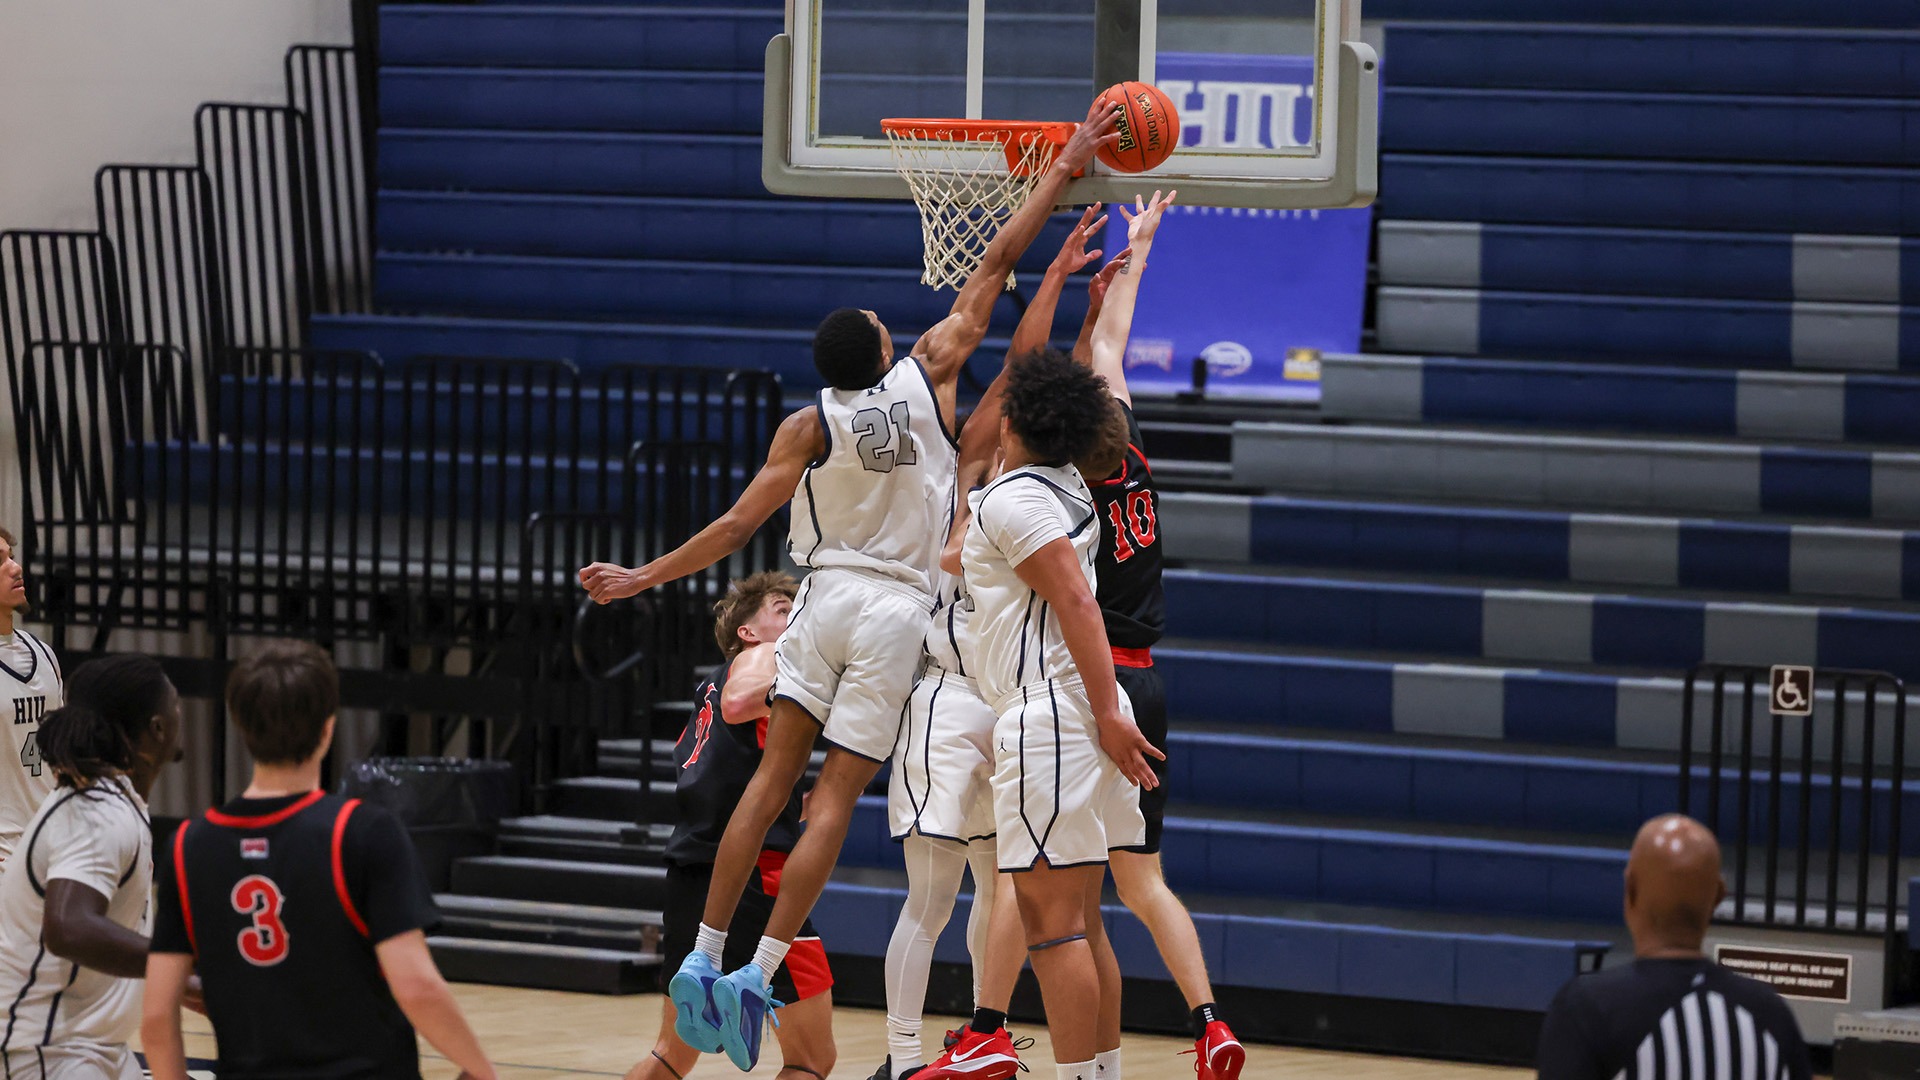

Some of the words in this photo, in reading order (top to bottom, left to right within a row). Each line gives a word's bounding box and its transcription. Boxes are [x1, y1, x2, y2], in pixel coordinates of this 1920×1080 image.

[1133, 92, 1160, 152] SPALDING
[851, 400, 917, 473] 21
[1108, 489, 1156, 563] 10
[12, 695, 46, 725] HIU
[20, 731, 42, 777] 4
[230, 874, 291, 967] 3
